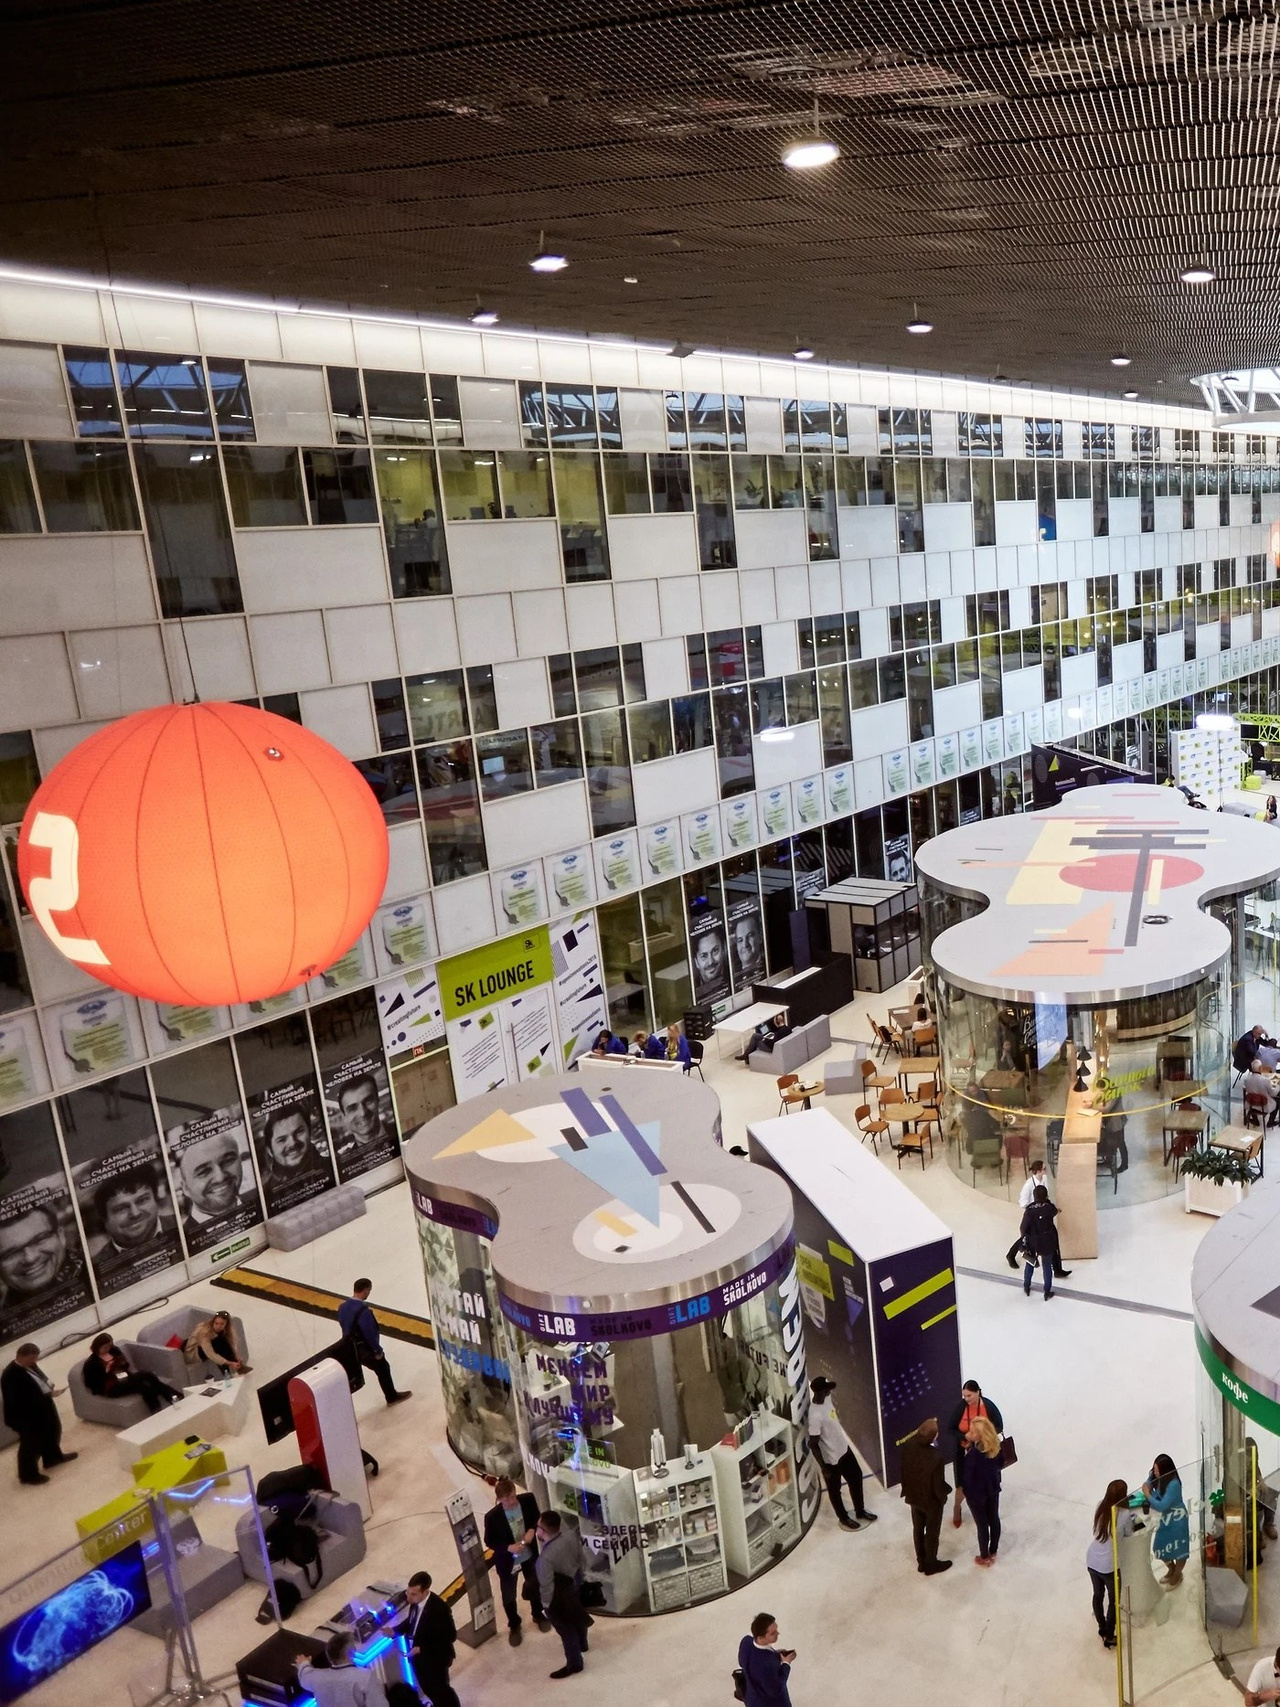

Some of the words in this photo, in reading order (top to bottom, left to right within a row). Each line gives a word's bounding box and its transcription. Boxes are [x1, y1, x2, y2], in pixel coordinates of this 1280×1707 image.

[28, 811, 112, 966] 2
[455, 986, 476, 1007] SK
[478, 960, 534, 998] LOUNGE
[325, 1075, 353, 1088] ЧЕЛОВЕК
[363, 1061, 382, 1073] ЗЕМЛЕ
[333, 1059, 373, 1079] СЧАСТЛИВЫЙ
[341, 1056, 363, 1070] САМЫЙ
[252, 1103, 283, 1118] ЧЕЛОВЕК
[283, 1099, 293, 1107] НА
[293, 1088, 315, 1103] ЗЕМЛЕ
[261, 1086, 305, 1108] СЧАСТЛИВЫЙ
[269, 1084, 294, 1099] САМЫЙ
[170, 1134, 206, 1151] ЧЕЛОВЕК
[206, 1131, 217, 1139] НА
[217, 1119, 241, 1134] ЗЕМЛЕ
[180, 1118, 229, 1142] СЧАСТЛИВЫЙ
[190, 1115, 218, 1131] САМЫЙ
[91, 1150, 146, 1178] СЧАСТЛИВЫЙ
[102, 1148, 133, 1166] САМЫЙ
[80, 1169, 119, 1188] ЧЕЛОВЕК
[119, 1163, 131, 1172] НА
[132, 1152, 158, 1169] ЗЕМЛЕ
[0, 1188, 49, 1214] АСТЛИВЫЙ
[21, 1204, 33, 1213] НА
[34, 1189, 65, 1207] ЗЕМЛЕ
[417, 1194, 433, 1216] LAB
[722, 1281, 745, 1295] MADE
[722, 1271, 767, 1306] SKOLKOVO
[676, 1295, 711, 1323] LAB
[544, 1315, 576, 1336] LAB
[590, 1319, 652, 1336] SKOLKOVO
[1221, 1371, 1249, 1404] кофе
[581, 1537, 589, 1547] И
